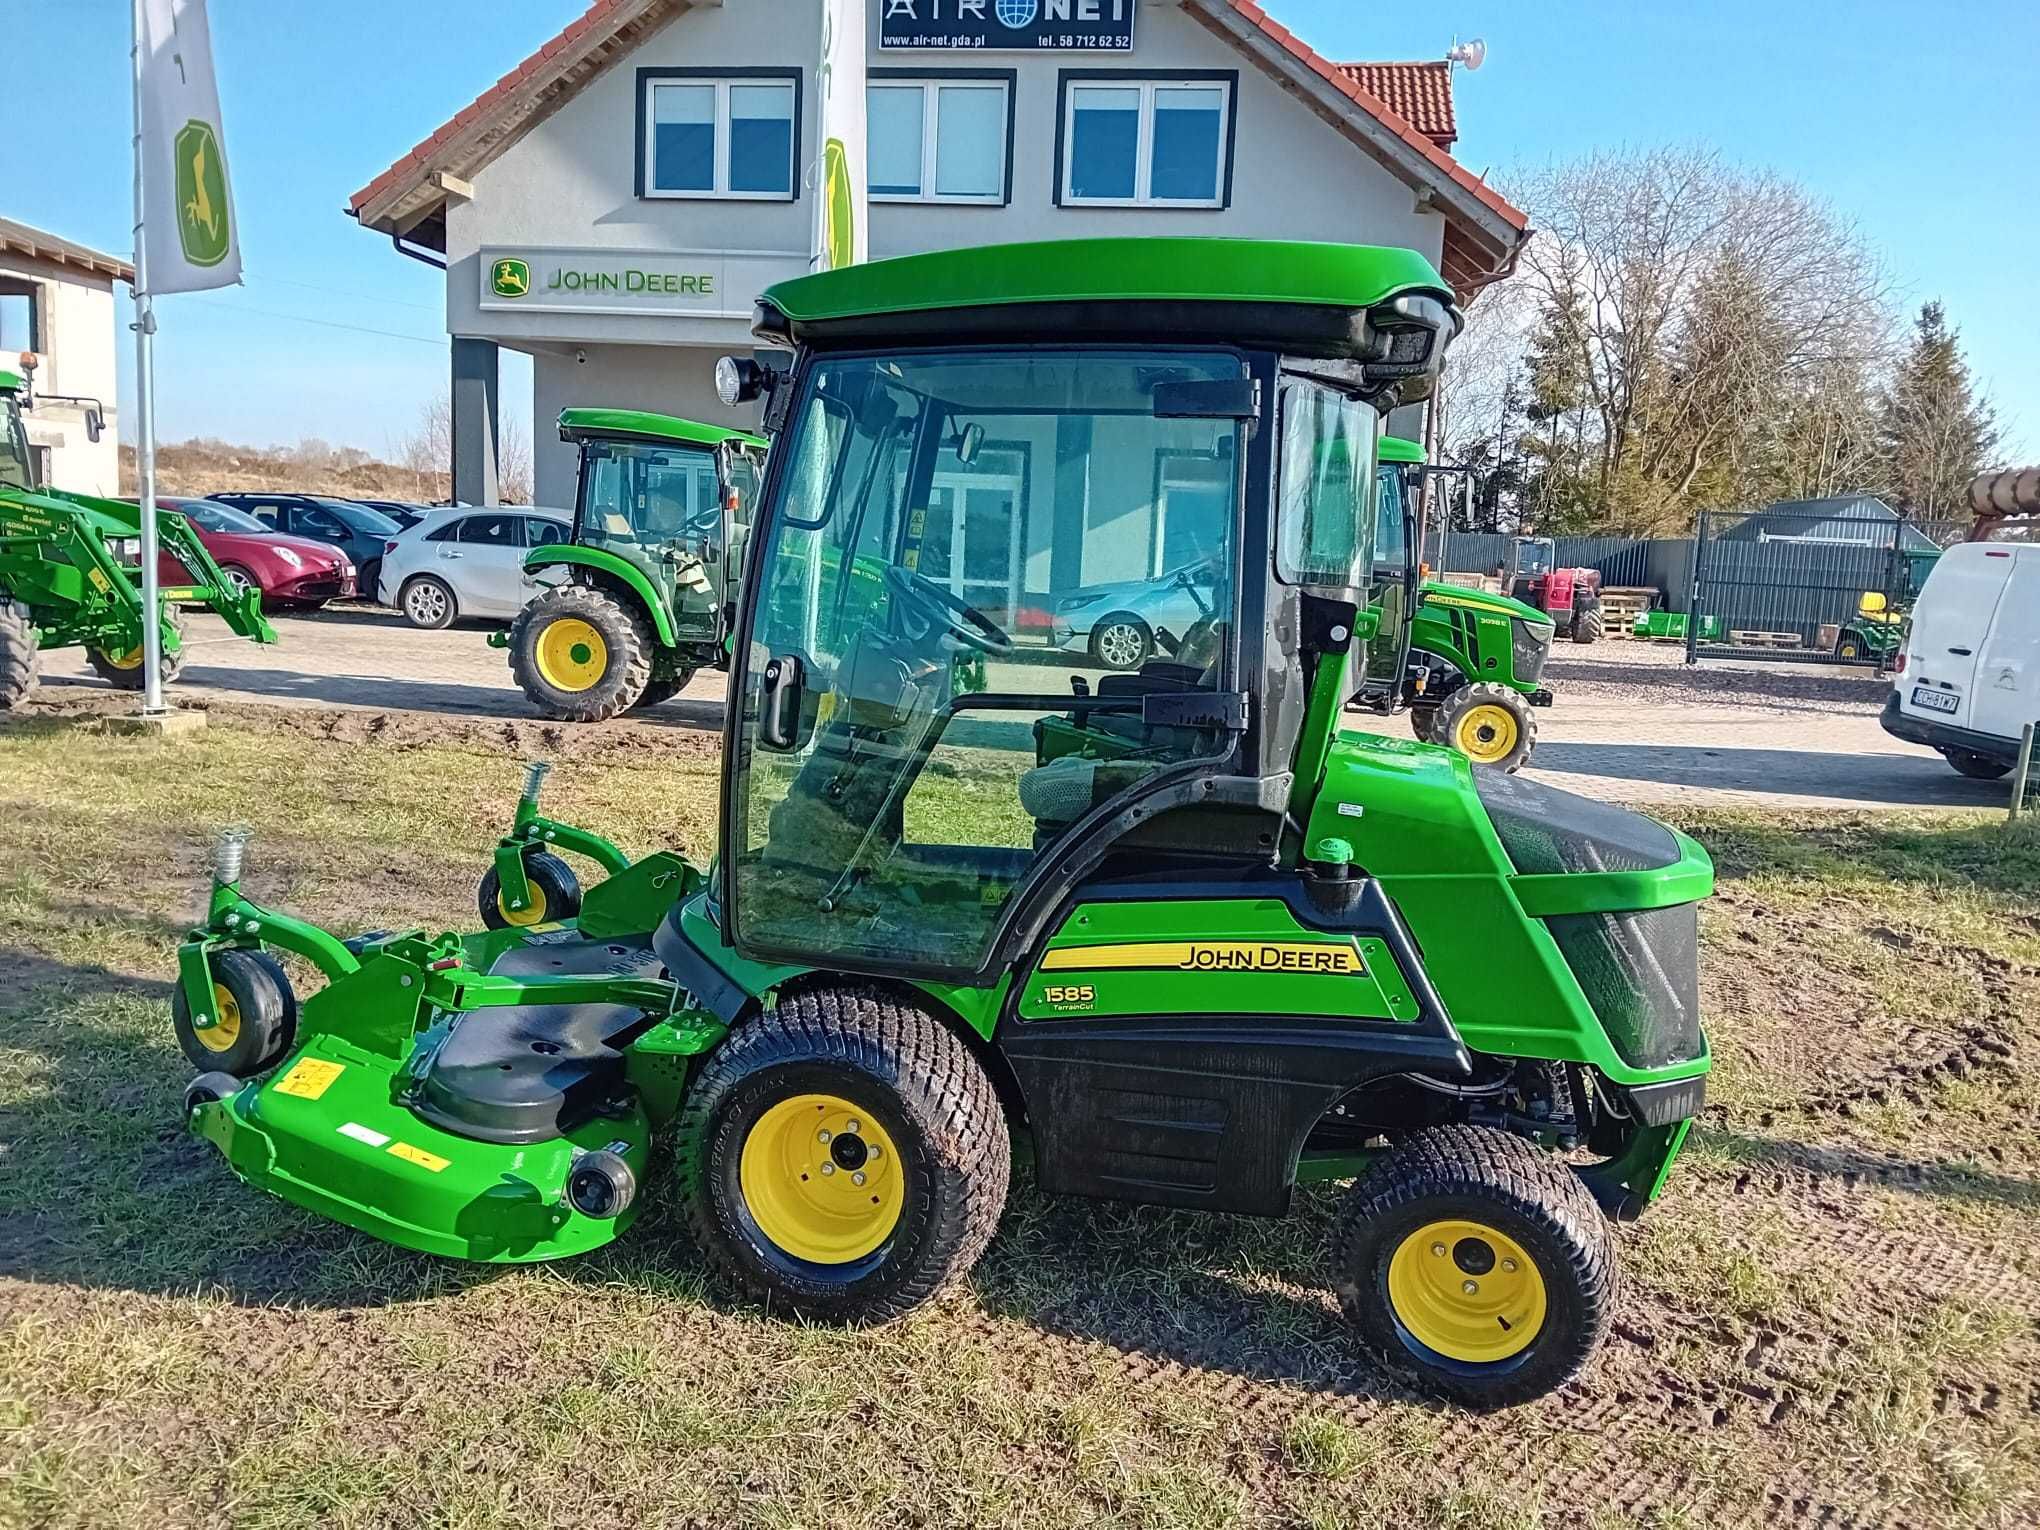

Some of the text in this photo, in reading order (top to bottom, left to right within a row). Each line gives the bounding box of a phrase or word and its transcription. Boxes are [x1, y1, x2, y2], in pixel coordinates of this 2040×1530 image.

[883, 34, 985, 48] www.air-net.gda.pl
[1038, 35, 1129, 47] tel. 58 712 62 52
[548, 268, 713, 293] JOHN DEERE
[1180, 945, 1349, 969] JOHN DEERE
[1044, 986, 1095, 1002] 1585
[1053, 1003, 1095, 1011] TerrainCut
